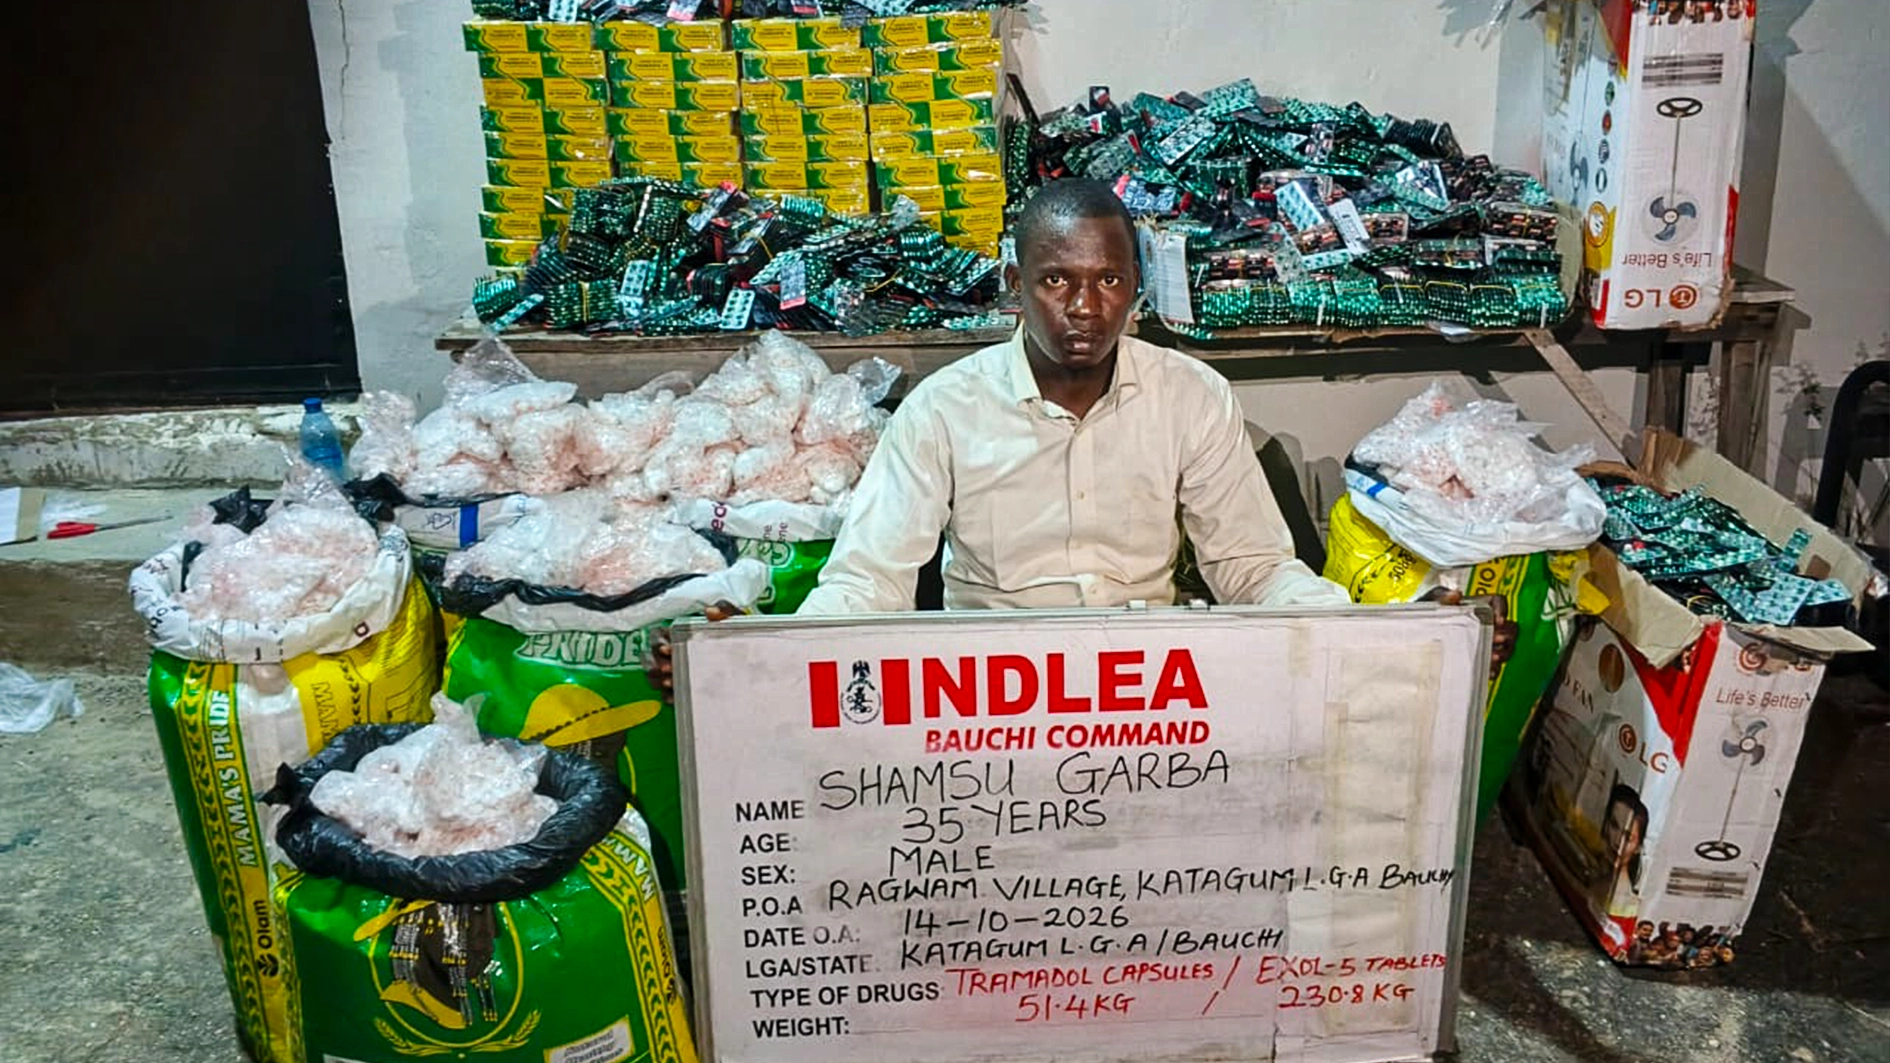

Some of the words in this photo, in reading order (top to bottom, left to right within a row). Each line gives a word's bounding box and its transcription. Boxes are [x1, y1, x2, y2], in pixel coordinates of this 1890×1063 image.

[1621, 251, 1668, 269] Better
[1672, 251, 1712, 268] Life's
[1625, 288, 1661, 308] LG
[922, 649, 1208, 718] NDLEA
[1715, 688, 1756, 707] Life's
[1760, 691, 1806, 710] Better
[925, 726, 1036, 755] BAUCHI
[1047, 720, 1209, 749] COMMAND
[1639, 741, 1669, 774] LG
[819, 759, 1015, 811] SHAMSU
[1056, 749, 1230, 796] GARBA
[223, 765, 258, 868] MAMA'S
[735, 800, 805, 823] NAME
[902, 807, 965, 844] 35
[971, 799, 1107, 836] YEARS
[741, 864, 796, 886] SEX:
[889, 845, 996, 877] MALE
[993, 873, 1126, 902] VILLAGE,
[1137, 867, 1294, 901] KATAGUM
[252, 898, 273, 951] Olam
[744, 926, 806, 948] DATE
[901, 939, 1048, 969] KATAGUM
[945, 966, 1092, 996] TRAMADOL
[1104, 962, 1214, 985] CAPSULES
[1366, 954, 1447, 971] TABLETS
[750, 988, 811, 1009] TYPE
[818, 986, 849, 1005] OF
[752, 1016, 850, 1039] WEIGHT:
